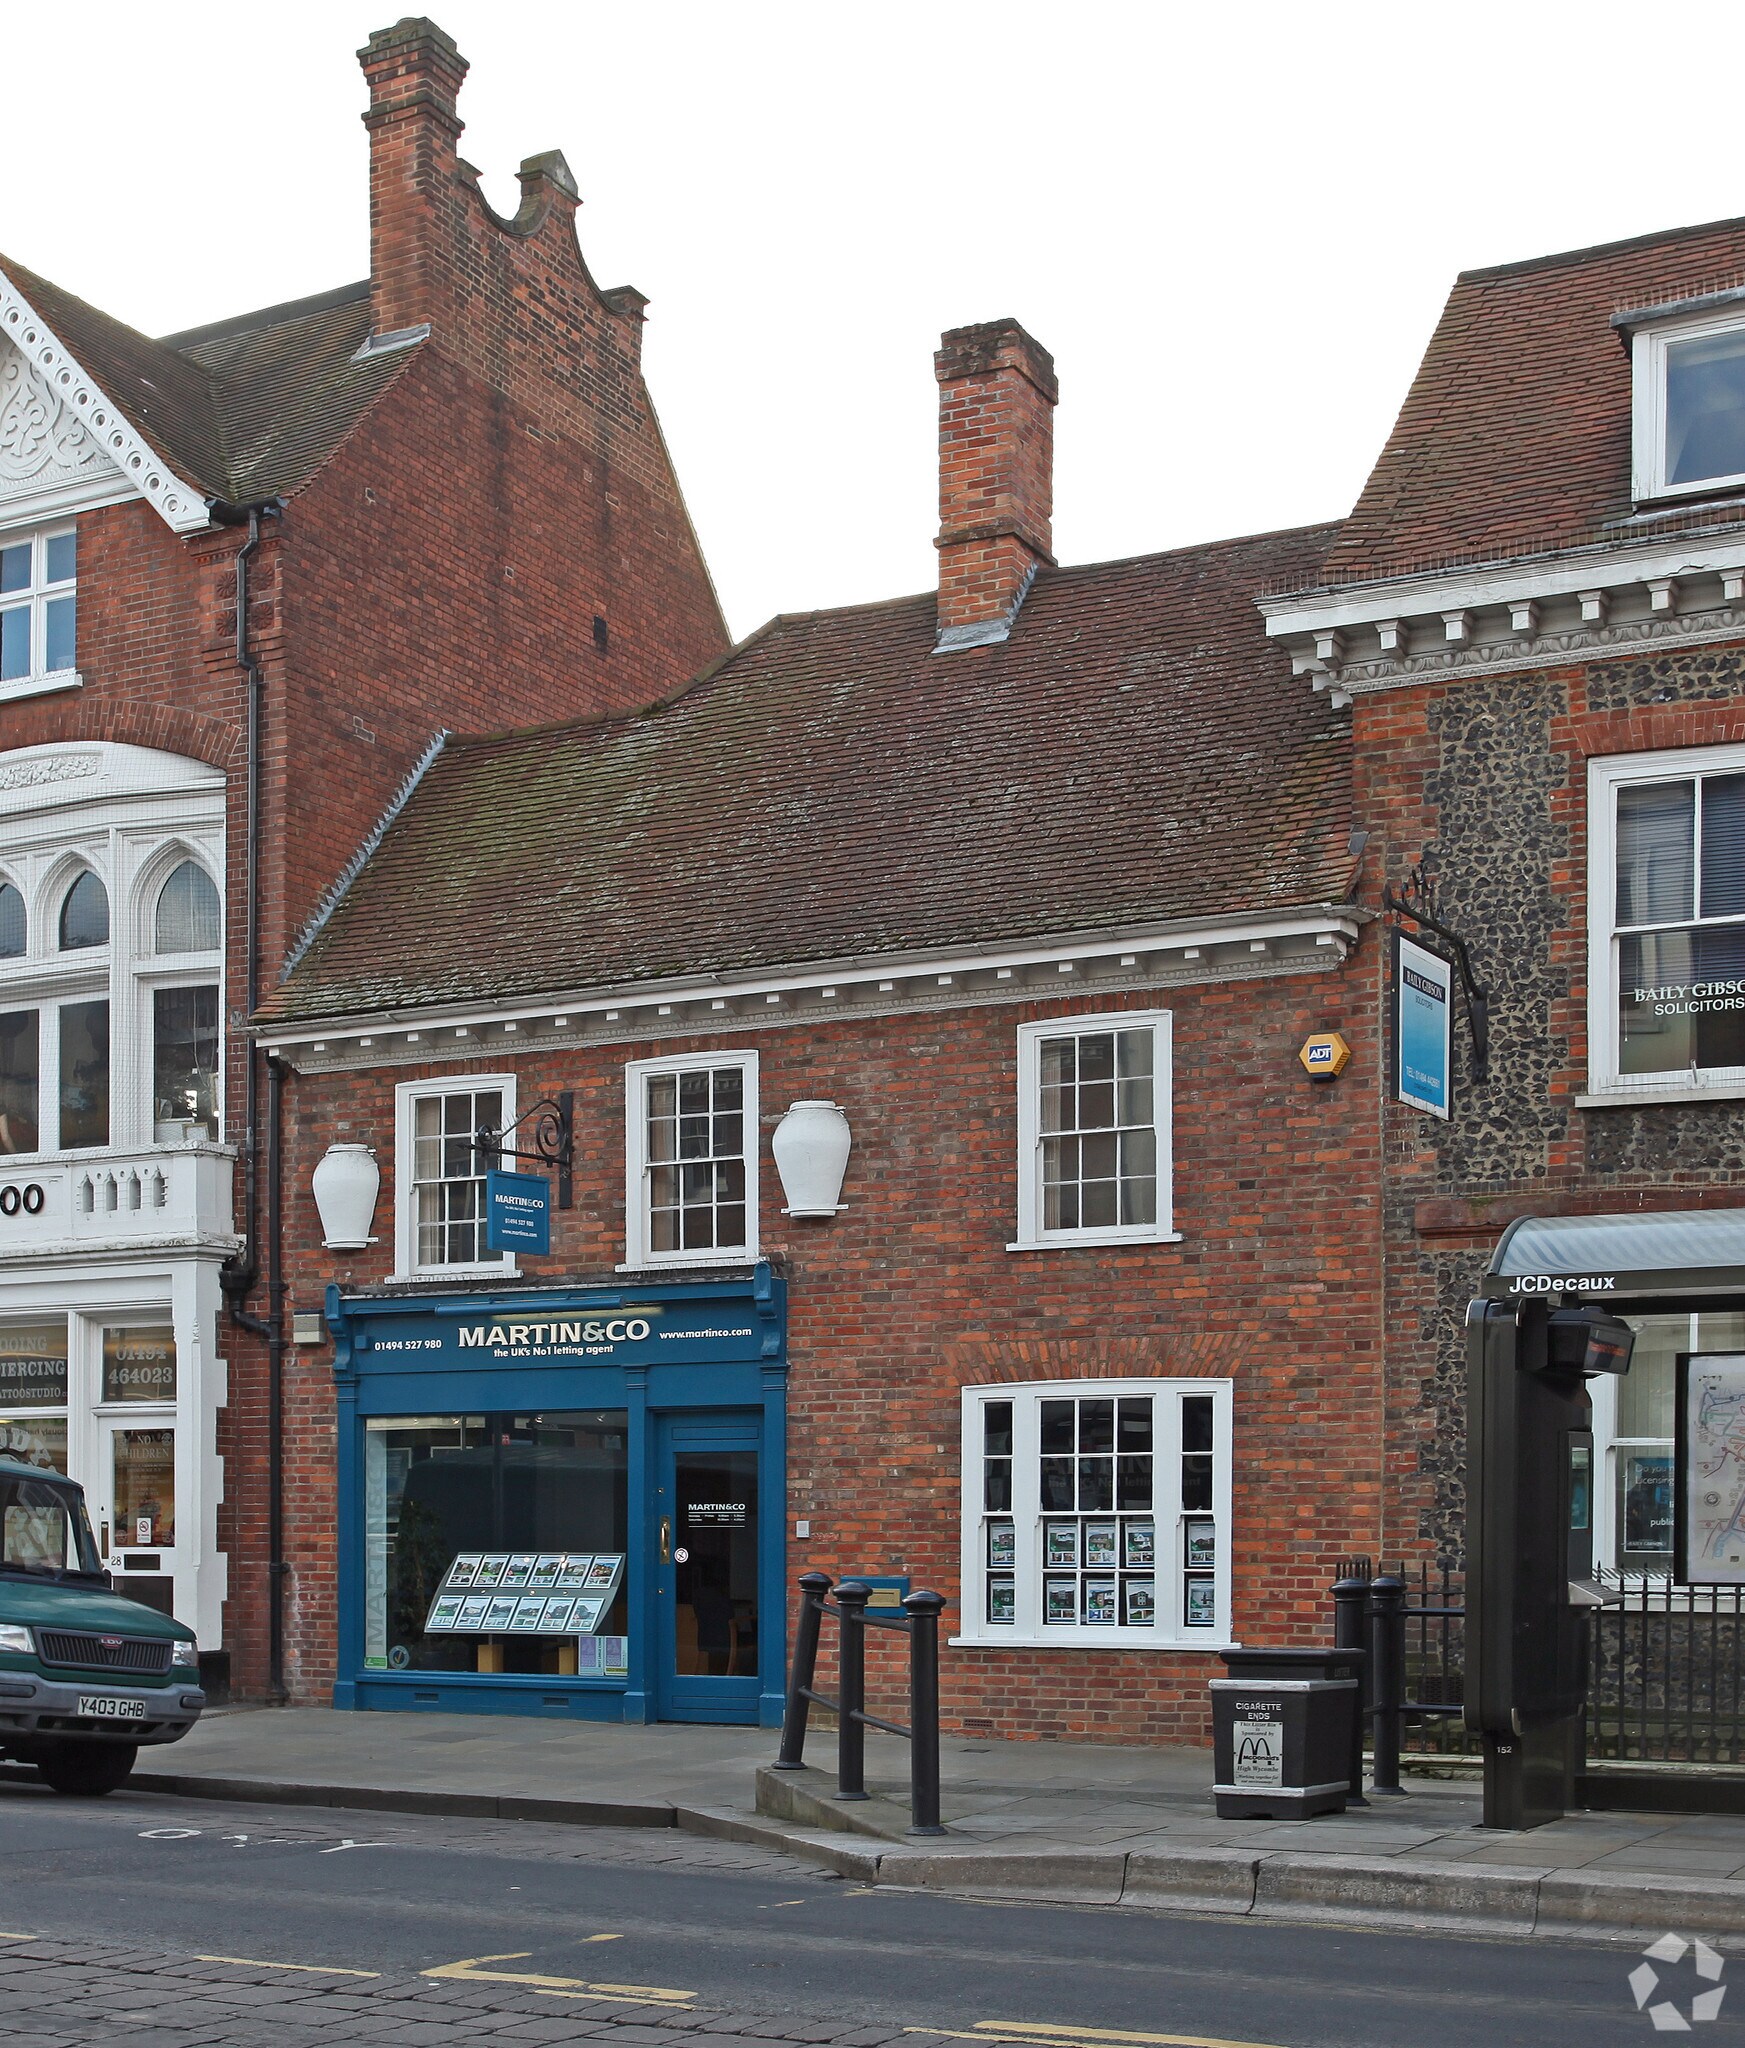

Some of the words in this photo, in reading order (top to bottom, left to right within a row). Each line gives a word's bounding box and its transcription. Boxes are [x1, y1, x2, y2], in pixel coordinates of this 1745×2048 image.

[1406, 970, 1422, 990] BAILY
[1422, 979, 1443, 1000] GIBSON
[1634, 984, 1687, 1003] BAILY
[1654, 997, 1745, 1016] SOLICITORS
[1308, 1045, 1332, 1060] ADT
[495, 1194, 544, 1208] MARTIN&CO
[1509, 1276, 1616, 1293] JCDecaux
[458, 1319, 651, 1348] MARTIN&CO
[659, 1327, 752, 1339] www.martinco.com
[374, 1341, 403, 1351] 01494
[405, 1340, 422, 1350] 527
[424, 1339, 442, 1349] 980
[494, 1348, 508, 1358] the
[511, 1347, 530, 1357] UK's
[533, 1346, 551, 1356] No1
[554, 1344, 583, 1356] letting
[586, 1344, 613, 1355] agent
[115, 1344, 167, 1361] 01494
[0, 1360, 65, 1378] IERCING
[108, 1366, 173, 1385] 464023
[137, 1435, 152, 1445] NO
[119, 1448, 170, 1459] CHILDREN
[1635, 1464, 1649, 1472] Do
[1651, 1466, 1666, 1474] you
[110, 1556, 122, 1566] 28
[100, 1637, 123, 1646] LDV
[80, 1698, 117, 1715] Y403
[119, 1700, 144, 1717] GHB
[1235, 1702, 1282, 1711] CIGARETTE
[1247, 1712, 1271, 1720] ENDS
[1496, 1746, 1512, 1754] 152
